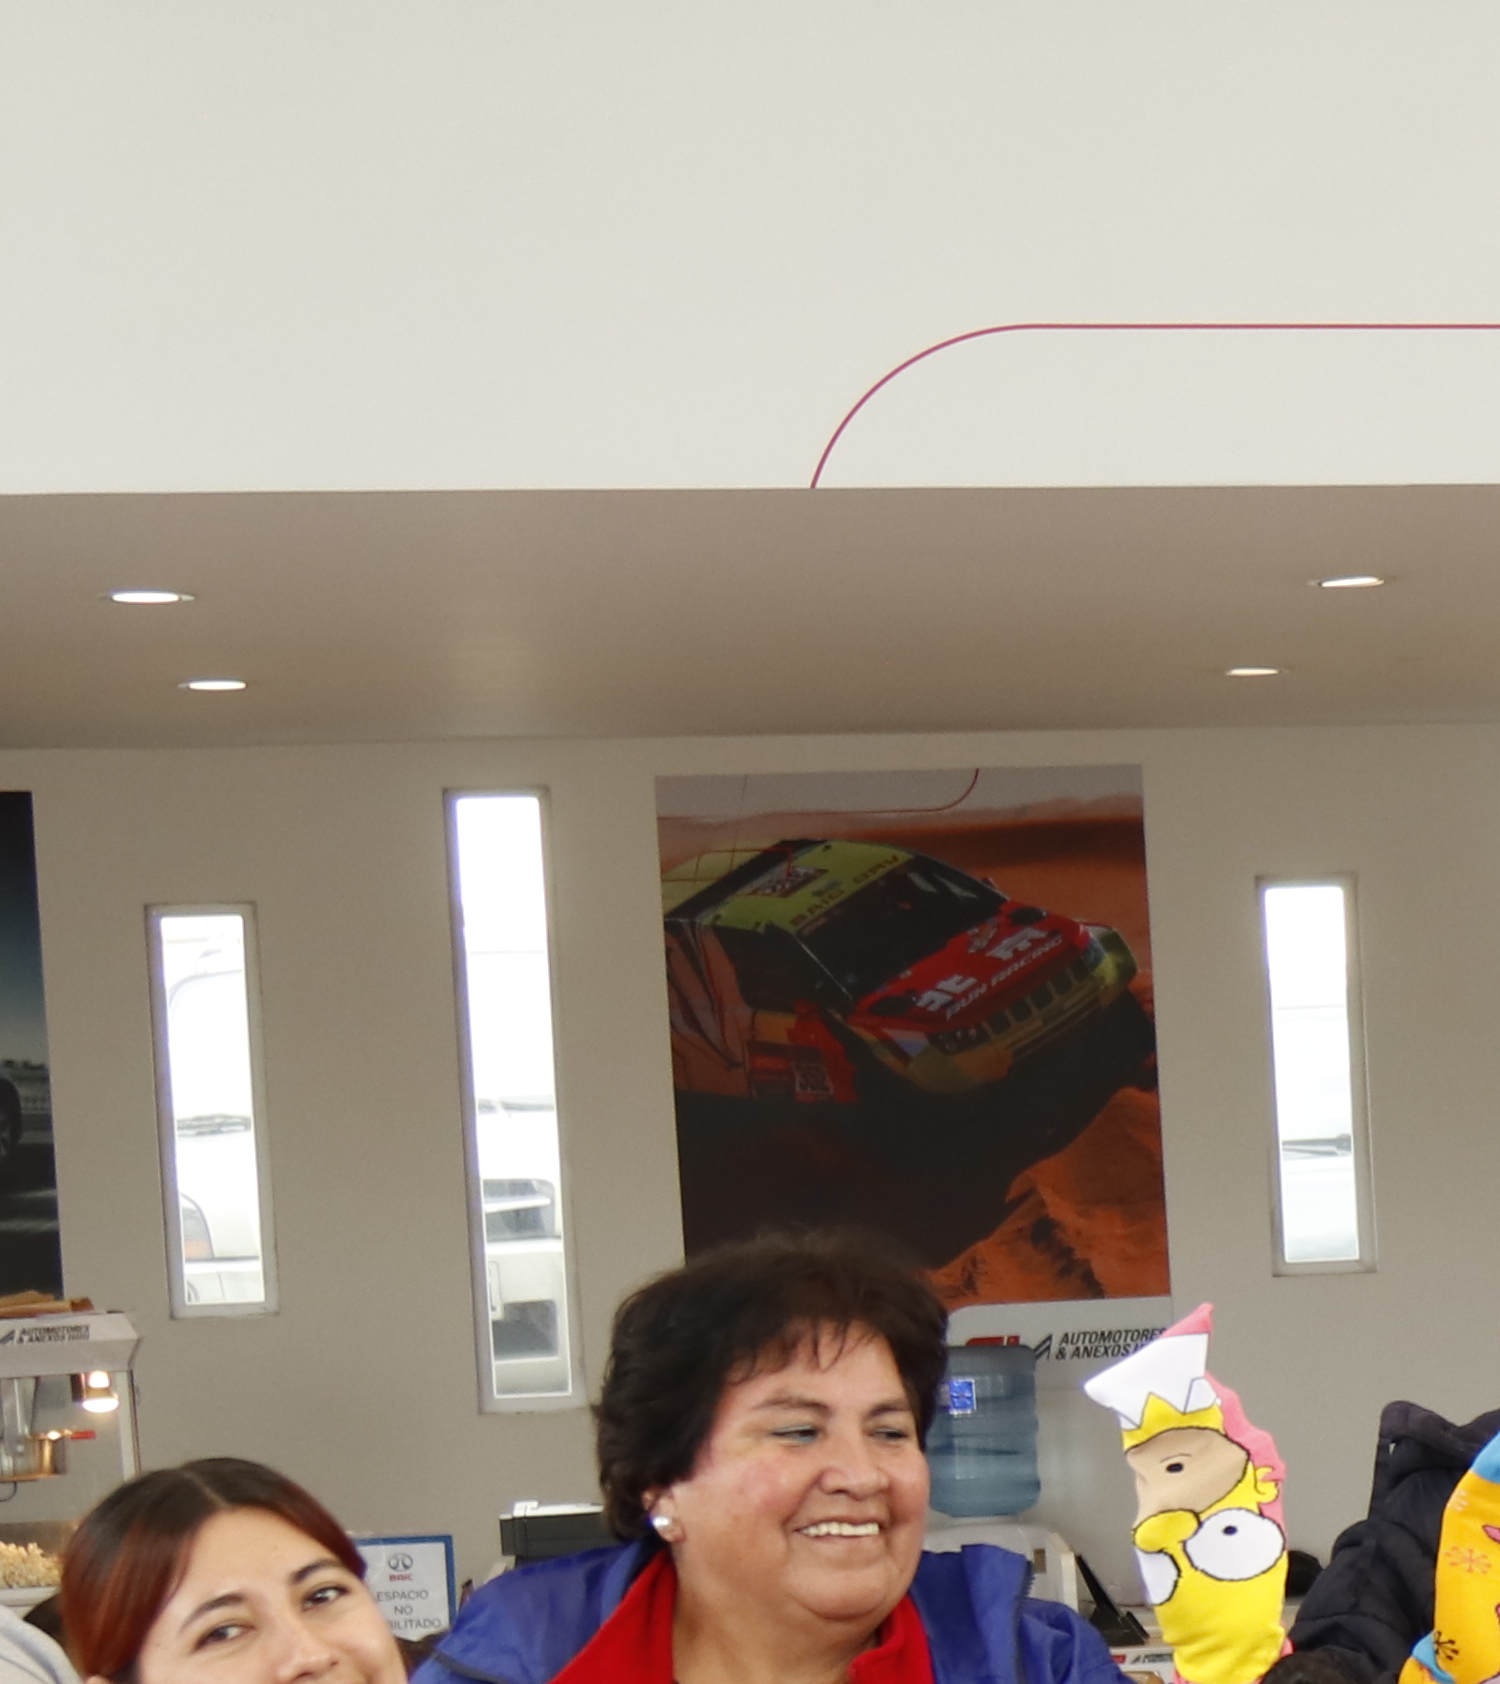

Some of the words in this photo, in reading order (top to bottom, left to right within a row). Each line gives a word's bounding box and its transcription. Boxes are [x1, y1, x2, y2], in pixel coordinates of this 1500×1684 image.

[1055, 1346, 1066, 1360] &
[376, 1589, 429, 1602] ESPACIO
[394, 1605, 413, 1616] NO
